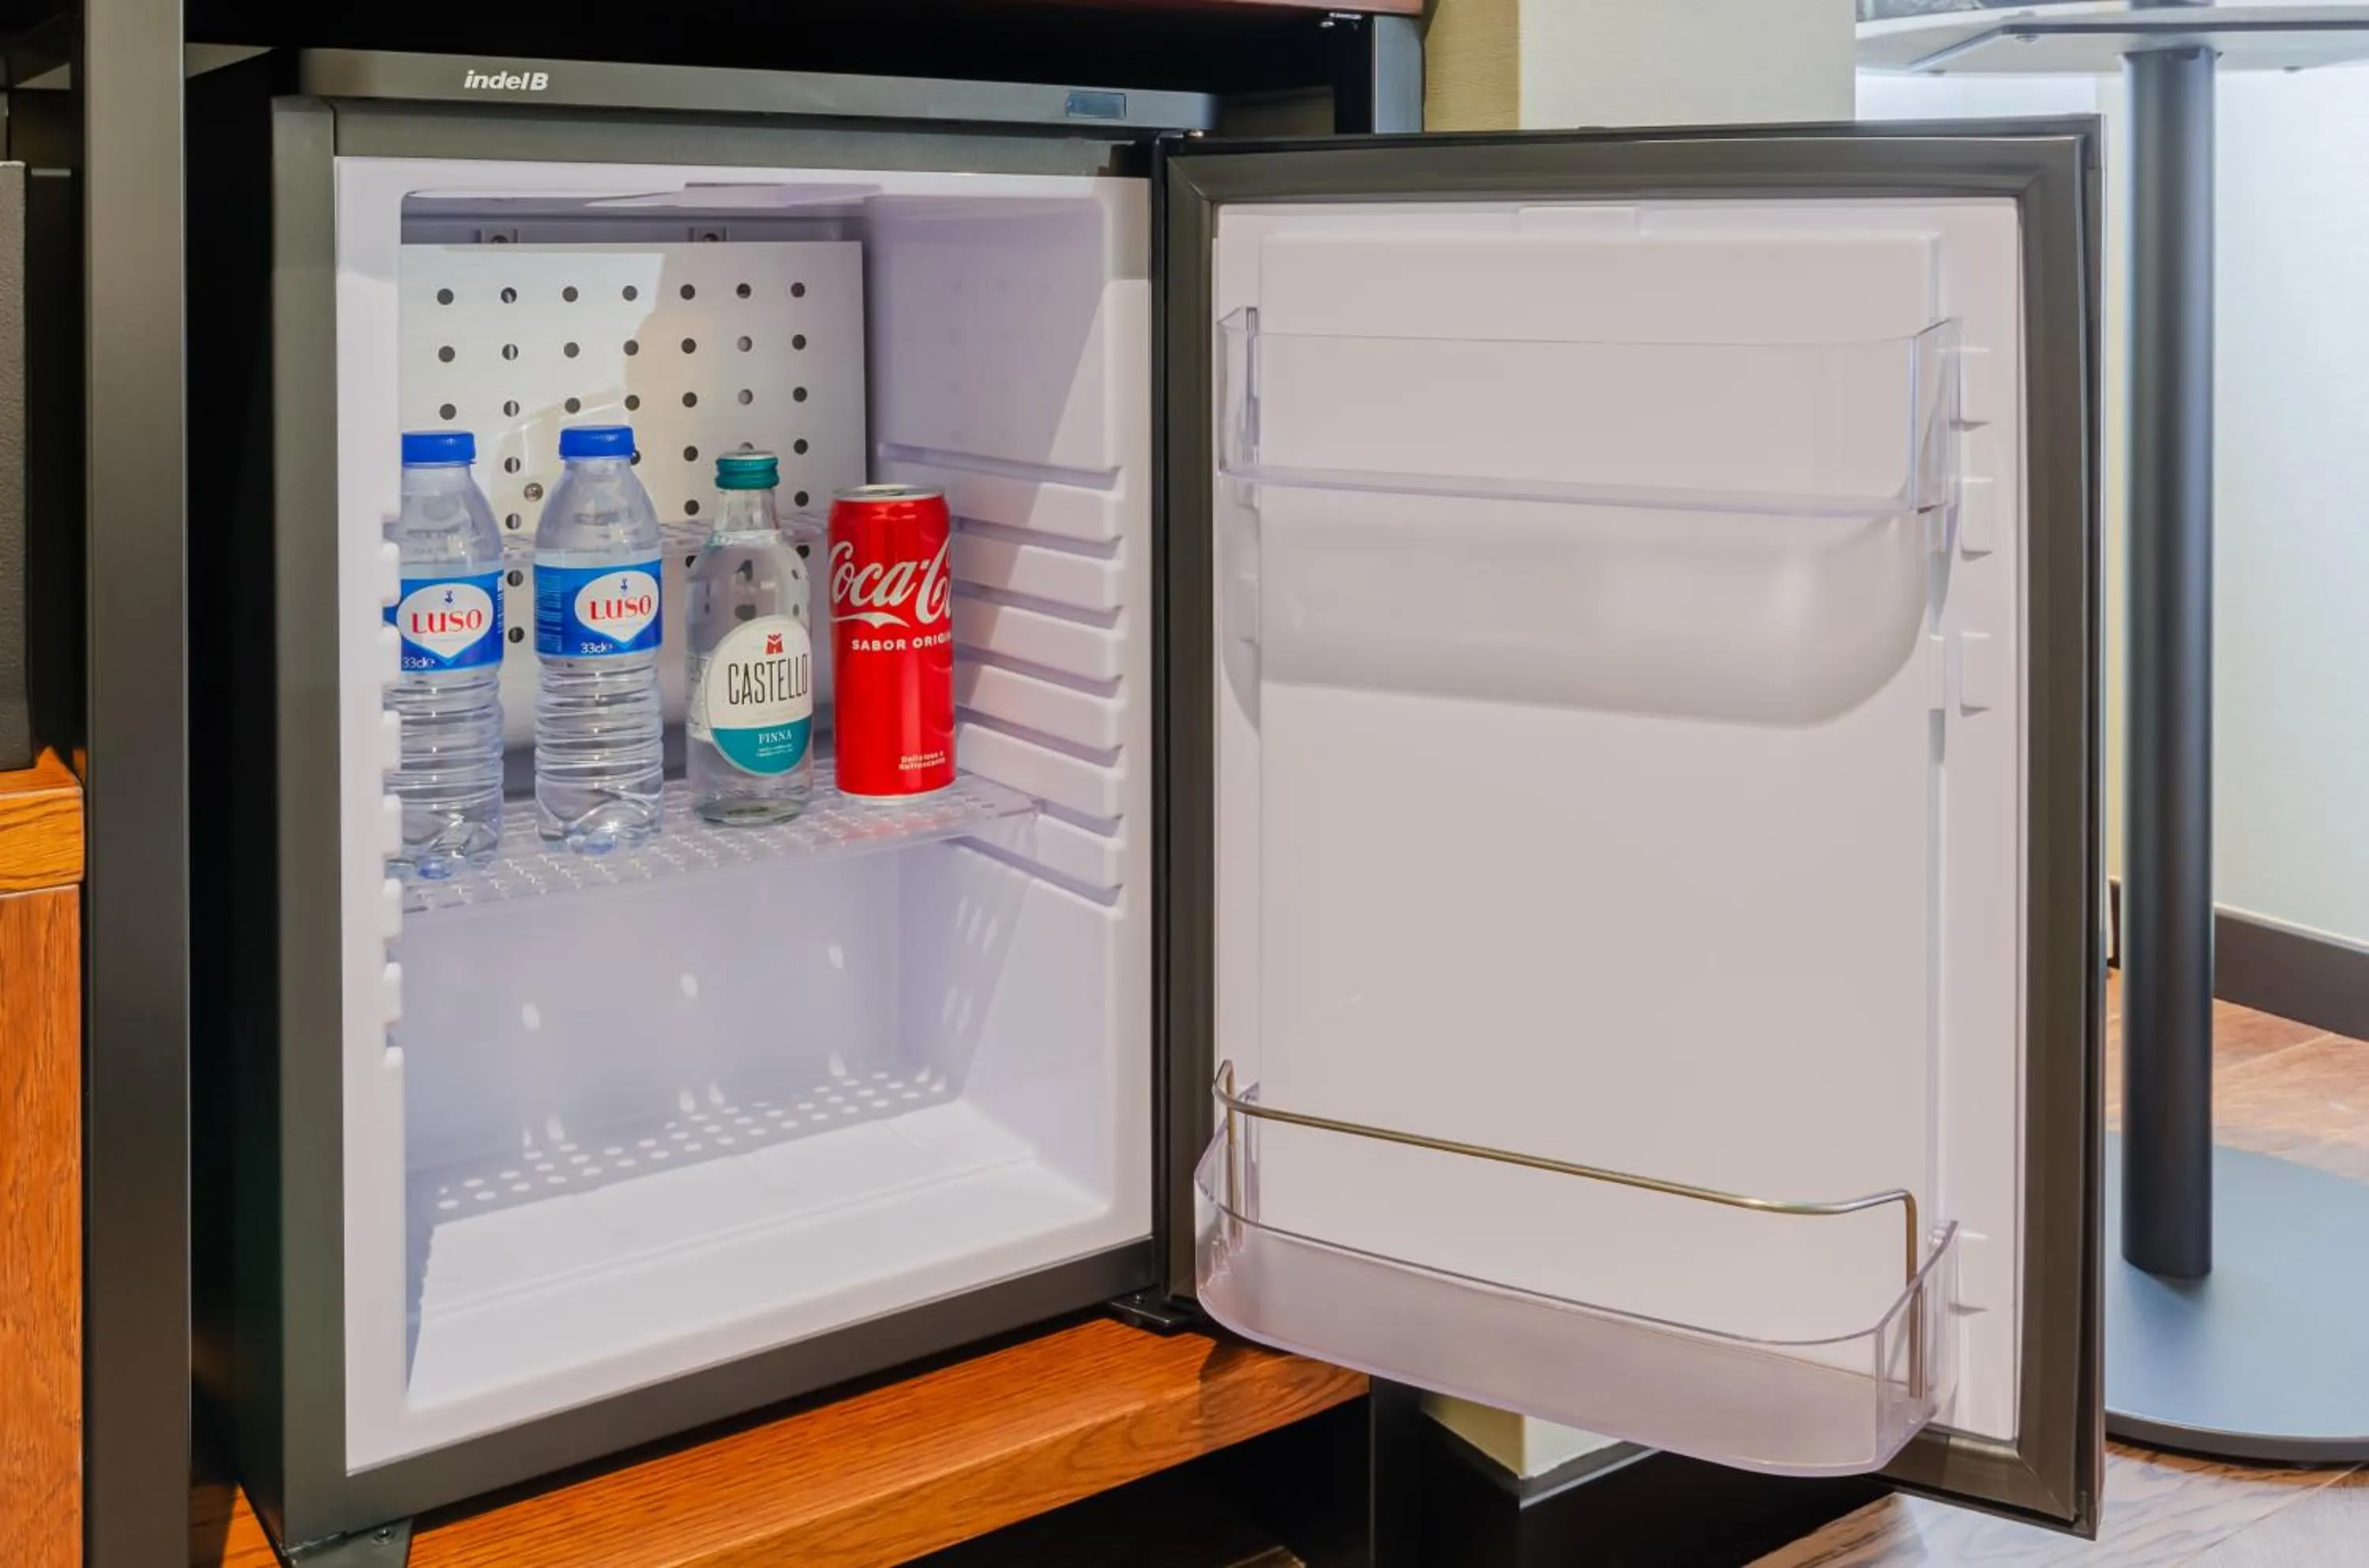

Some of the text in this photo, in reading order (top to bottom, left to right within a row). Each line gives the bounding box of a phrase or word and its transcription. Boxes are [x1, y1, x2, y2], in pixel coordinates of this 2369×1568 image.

[590, 595, 651, 620] LUSO
[411, 609, 482, 634] LUSO
[852, 639, 907, 651] SABOR
[728, 653, 808, 705] CASTELLO
